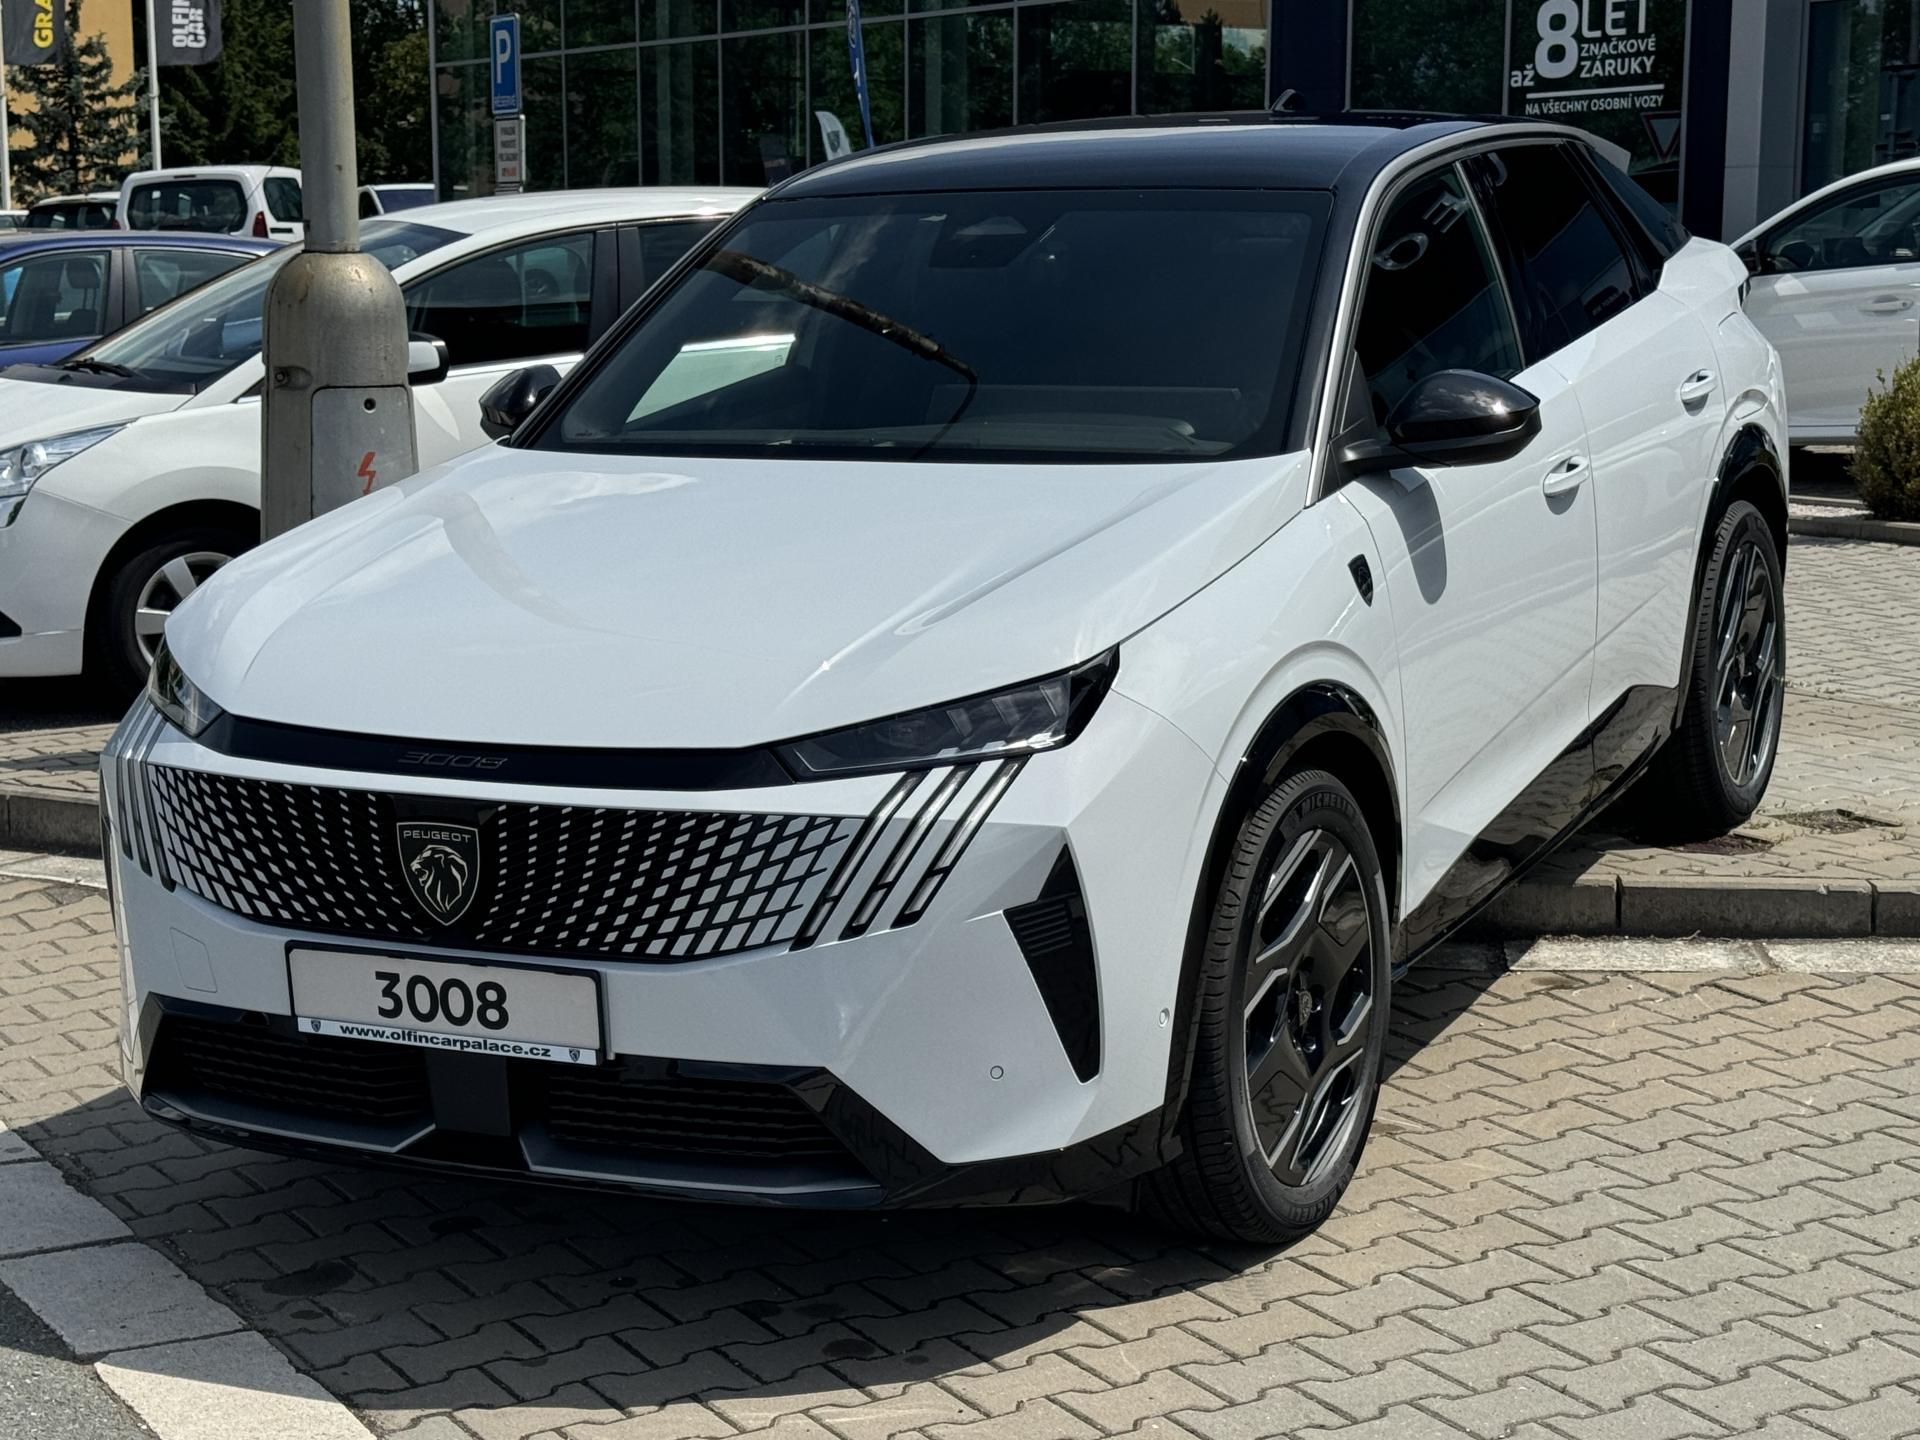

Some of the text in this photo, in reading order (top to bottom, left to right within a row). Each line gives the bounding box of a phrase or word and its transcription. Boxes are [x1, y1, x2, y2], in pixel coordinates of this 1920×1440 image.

[187, 7, 207, 48] CAR
[495, 29, 512, 84] P
[1510, 63, 1536, 88] až
[1534, 0, 1579, 79] 8
[1580, 33, 1656, 57] ZNAČKOVÉ
[1580, 55, 1656, 78] ZÁRUKY
[1525, 93, 1664, 115] NA VŠECHNY OSOBNÍ VOZY
[398, 750, 509, 770] 3008
[403, 829, 472, 843] PEUGEOT
[374, 970, 510, 1031] 3008
[339, 1023, 552, 1058] www.olfincarpalace.cz
